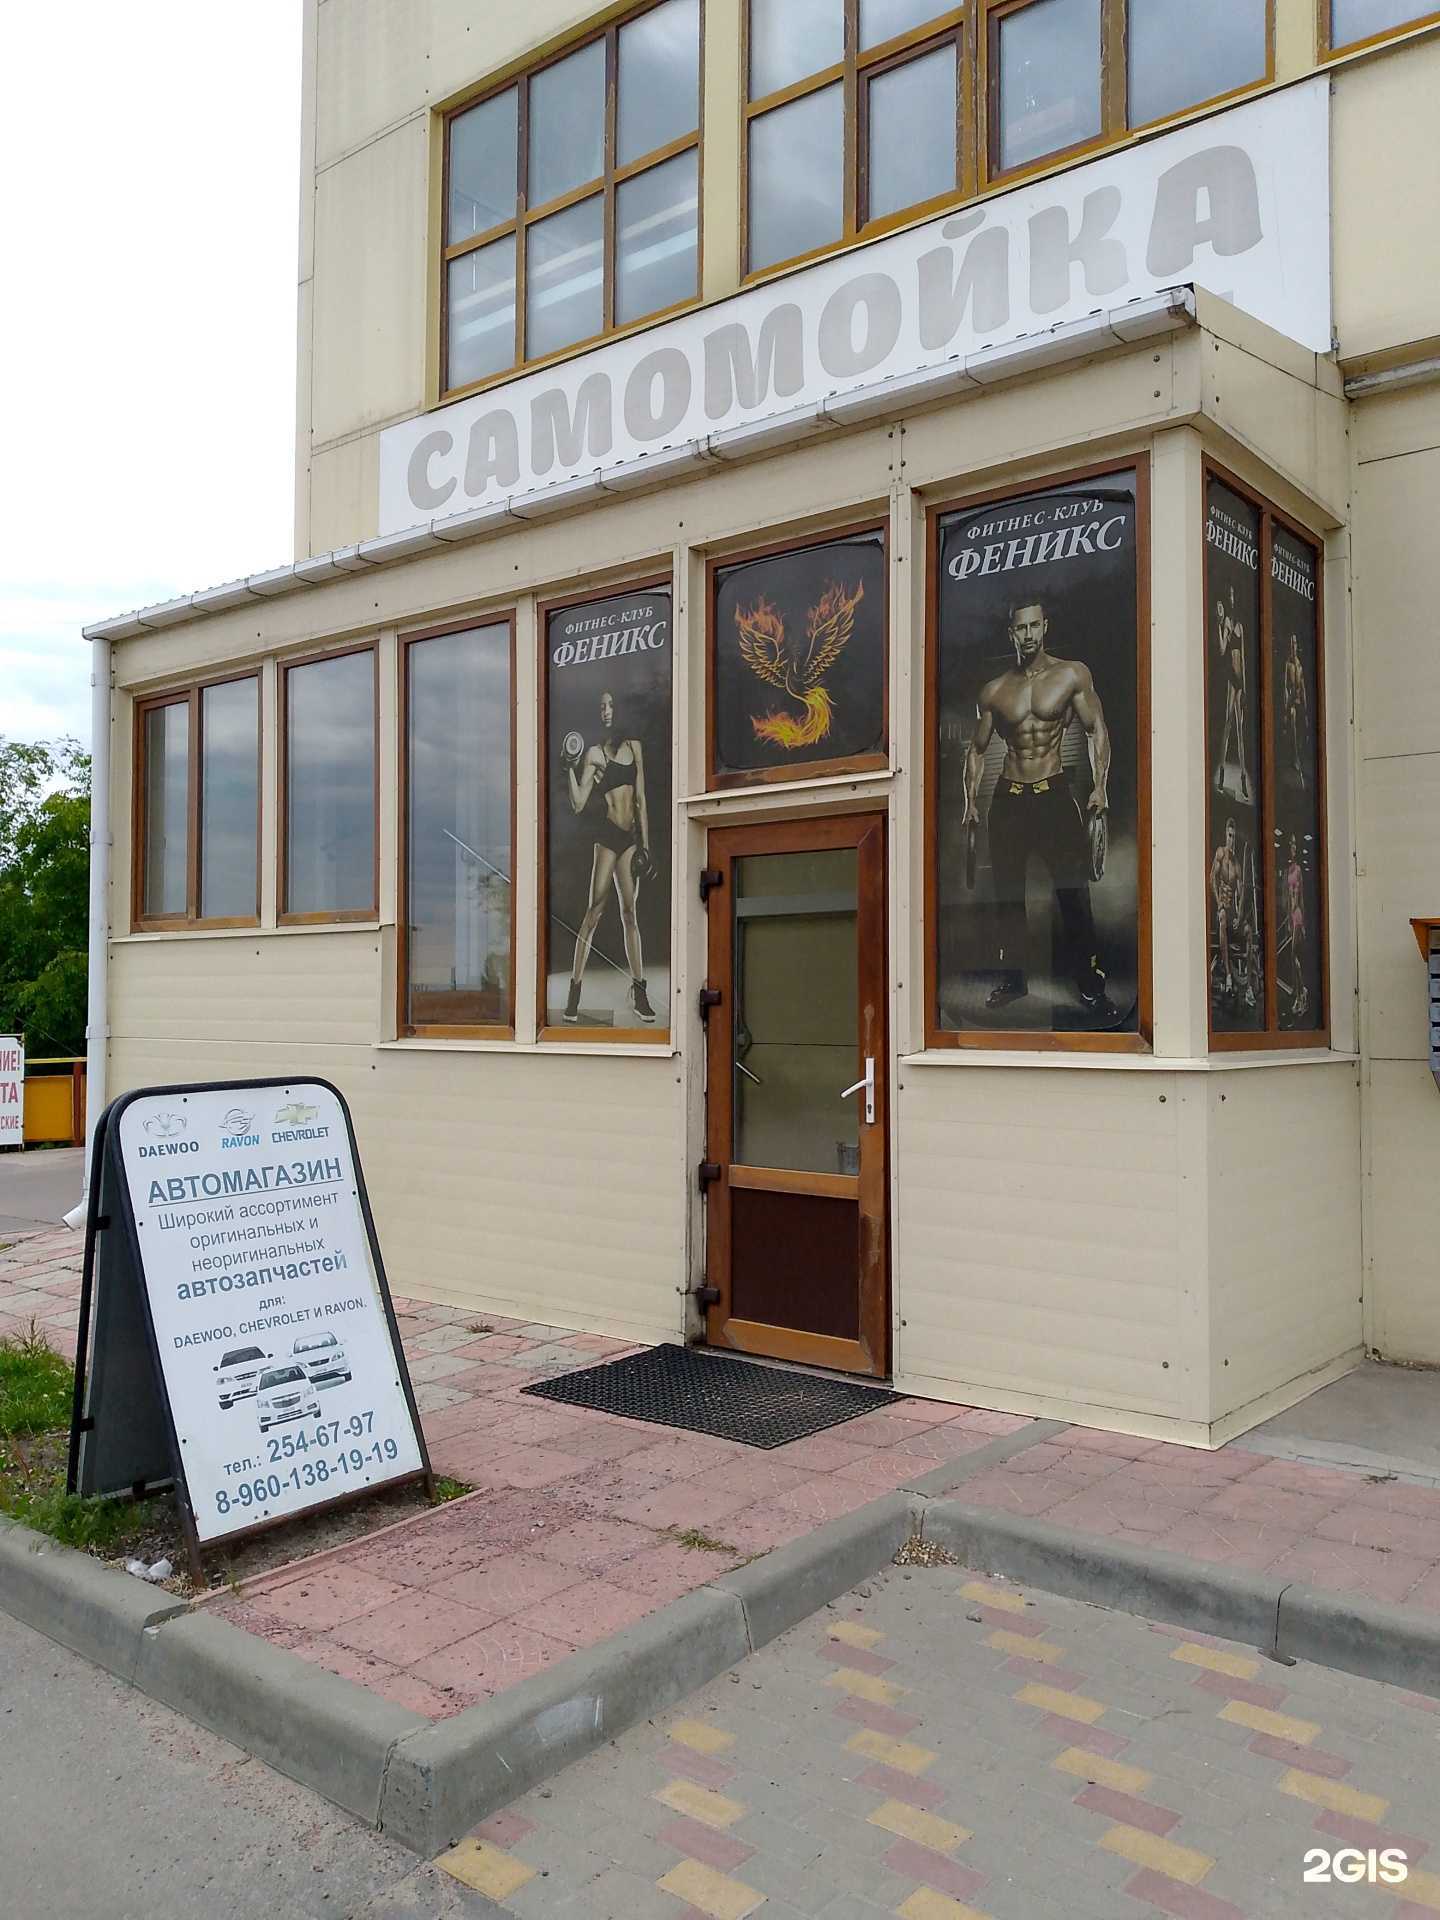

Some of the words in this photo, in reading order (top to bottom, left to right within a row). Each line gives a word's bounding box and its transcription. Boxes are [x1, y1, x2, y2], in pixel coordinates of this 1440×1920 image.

[407, 144, 1263, 511] САМОМОЙКА
[948, 515, 1126, 581] ФЕНИКС
[565, 606, 654, 635] ФИТНЕС-КЛУБ
[553, 621, 667, 667] ФЕНИКС
[138, 1141, 199, 1158] DAEWOO
[221, 1135, 260, 1149] RAVON
[271, 1126, 330, 1144] CHEVROLET
[148, 1157, 342, 1204] АВТОМАГАЗИН
[158, 1205, 234, 1231] Широкий
[239, 1191, 339, 1219] ассортимент
[190, 1219, 304, 1250] оригинальных
[309, 1217, 320, 1231] и
[176, 1250, 348, 1301] автозапчастей
[191, 1238, 325, 1273] неоригинальных
[174, 1326, 237, 1349] DAEWOO,
[239, 1310, 311, 1334] CHEVROLET
[314, 1306, 323, 1319] И
[325, 1298, 368, 1316] RAVON.
[258, 1295, 286, 1312] для:
[224, 1455, 262, 1476] тел.:
[266, 1411, 375, 1463] 254-67-97
[215, 1438, 398, 1514] 8-960-138-19-19
